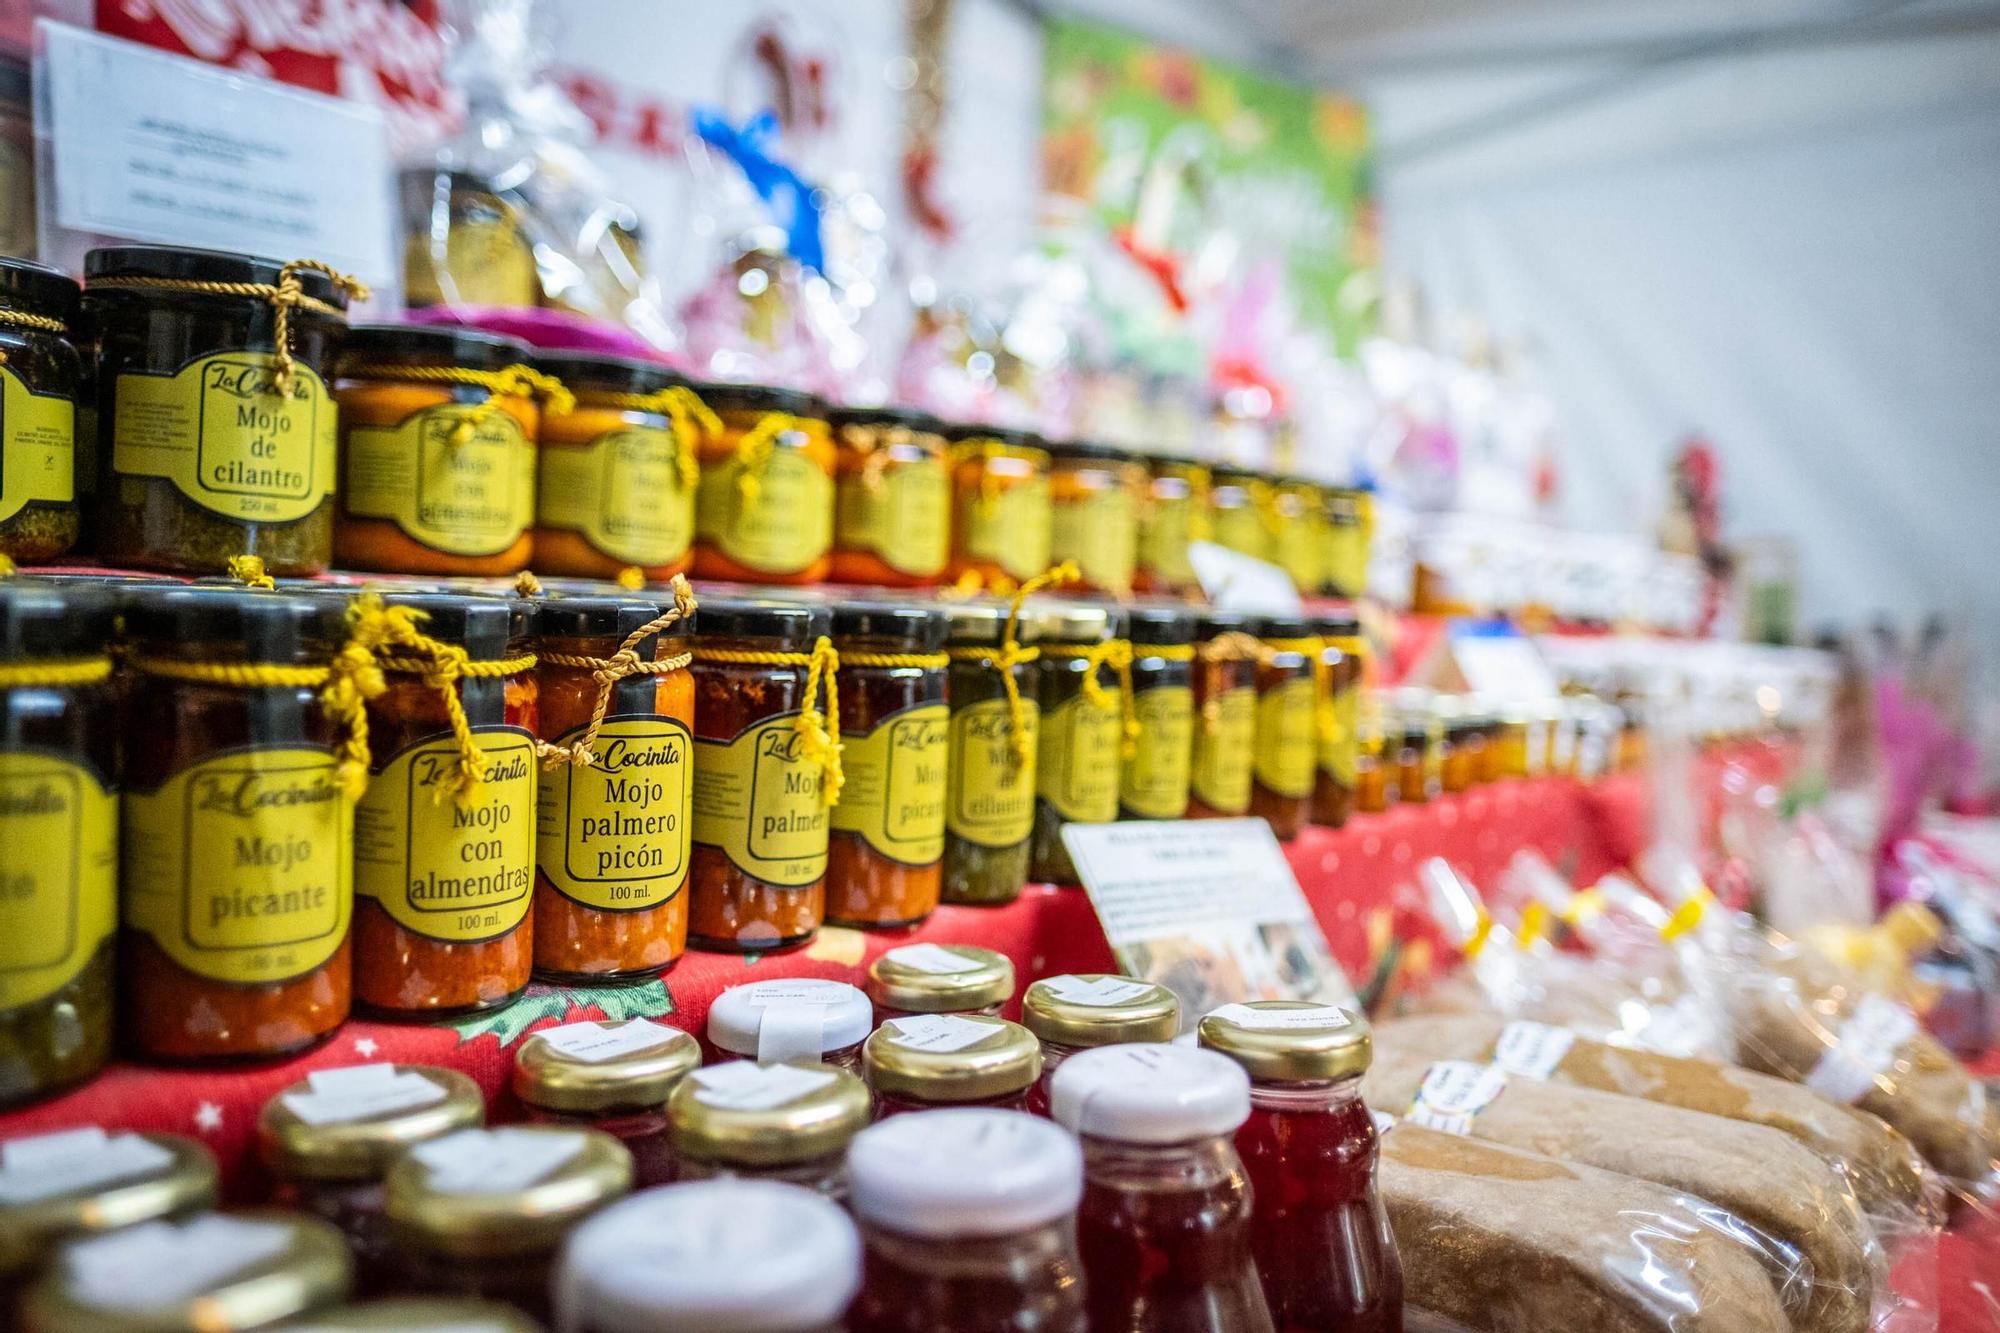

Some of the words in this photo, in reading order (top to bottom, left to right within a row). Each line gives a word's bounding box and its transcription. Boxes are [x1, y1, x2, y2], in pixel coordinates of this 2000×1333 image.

[237, 404, 291, 437] Mojo
[250, 435, 277, 459] de
[213, 460, 301, 488] cilantro
[604, 740, 680, 771] Cocinita
[605, 778, 663, 809] Mojo
[785, 772, 820, 797] Moj
[453, 799, 510, 833] Mojo
[581, 811, 676, 843] palmero
[235, 835, 312, 873] Mojo
[461, 838, 503, 863] con
[597, 844, 663, 876] picón
[411, 865, 528, 900] almendras
[609, 887, 631, 900] 100
[634, 885, 650, 899] ml.
[211, 885, 326, 928] picante
[457, 915, 480, 931] 100
[484, 911, 502, 928] ml.
